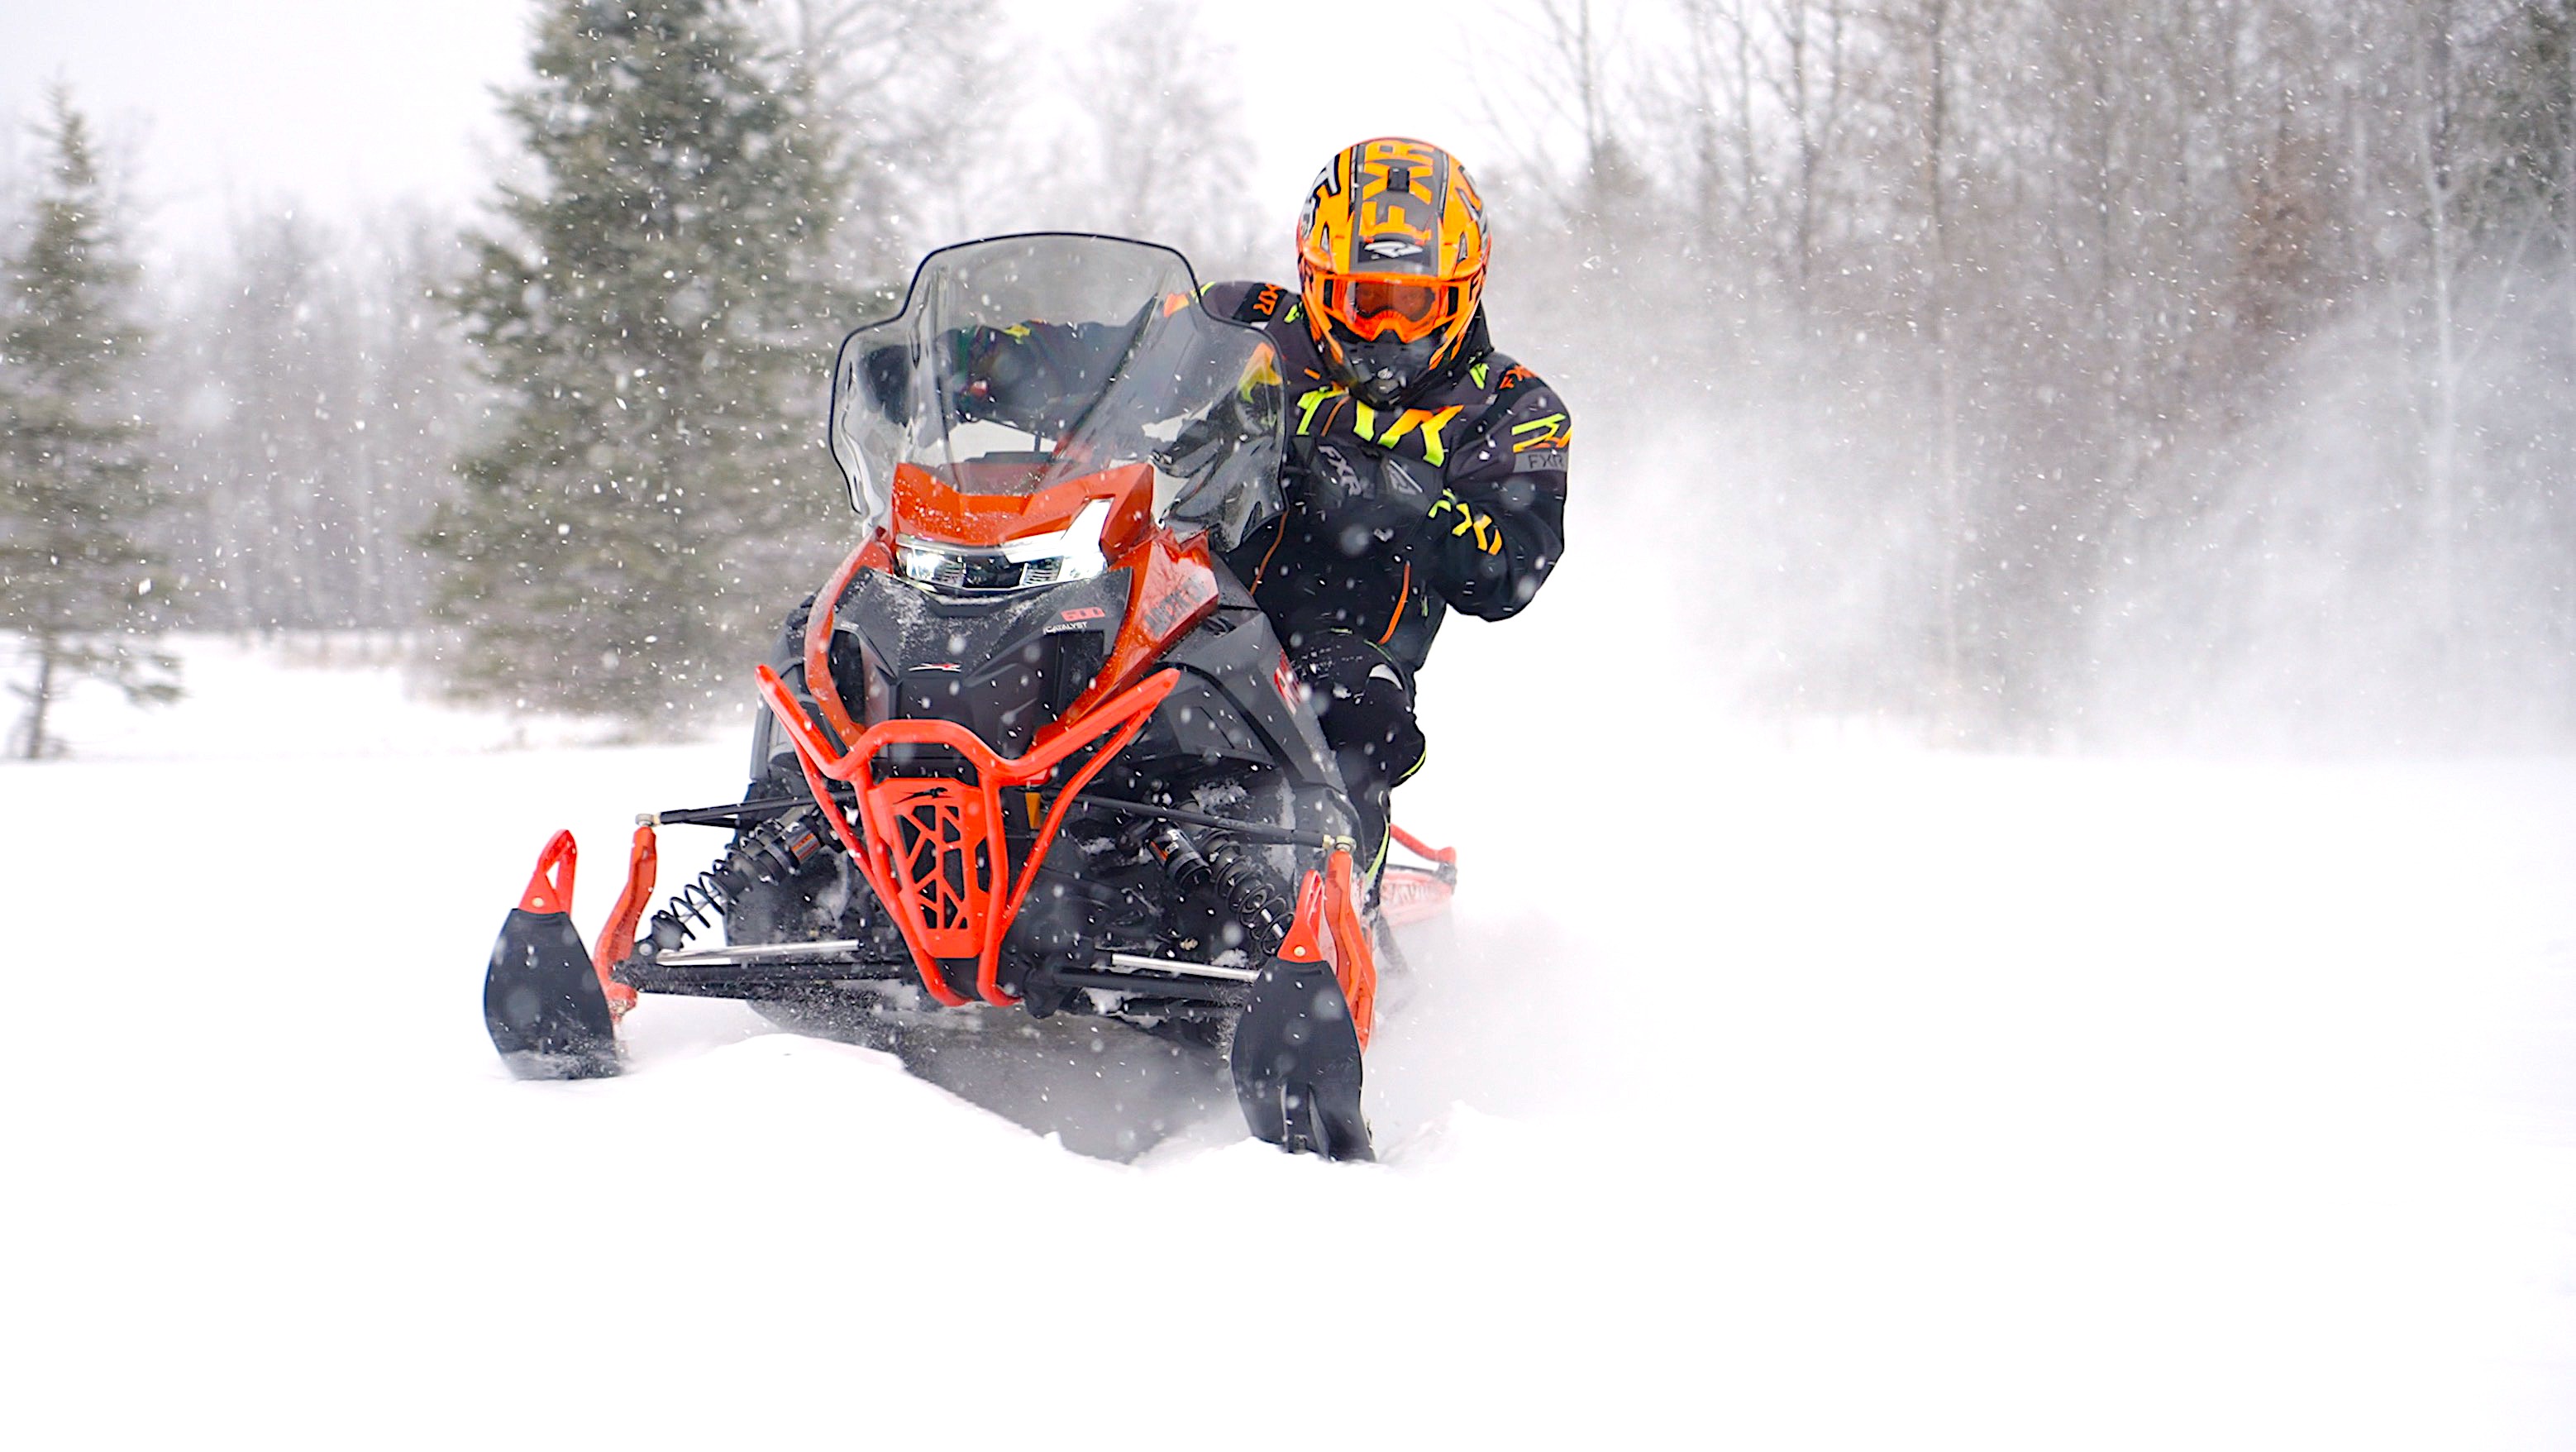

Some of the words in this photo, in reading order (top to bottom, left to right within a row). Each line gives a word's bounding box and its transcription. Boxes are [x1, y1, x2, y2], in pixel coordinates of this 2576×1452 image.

[1359, 140, 1434, 237] FXR
[1317, 445, 1362, 495] FXR
[1528, 453, 1563, 469] FXR
[1045, 621, 1088, 635] CATALYST
